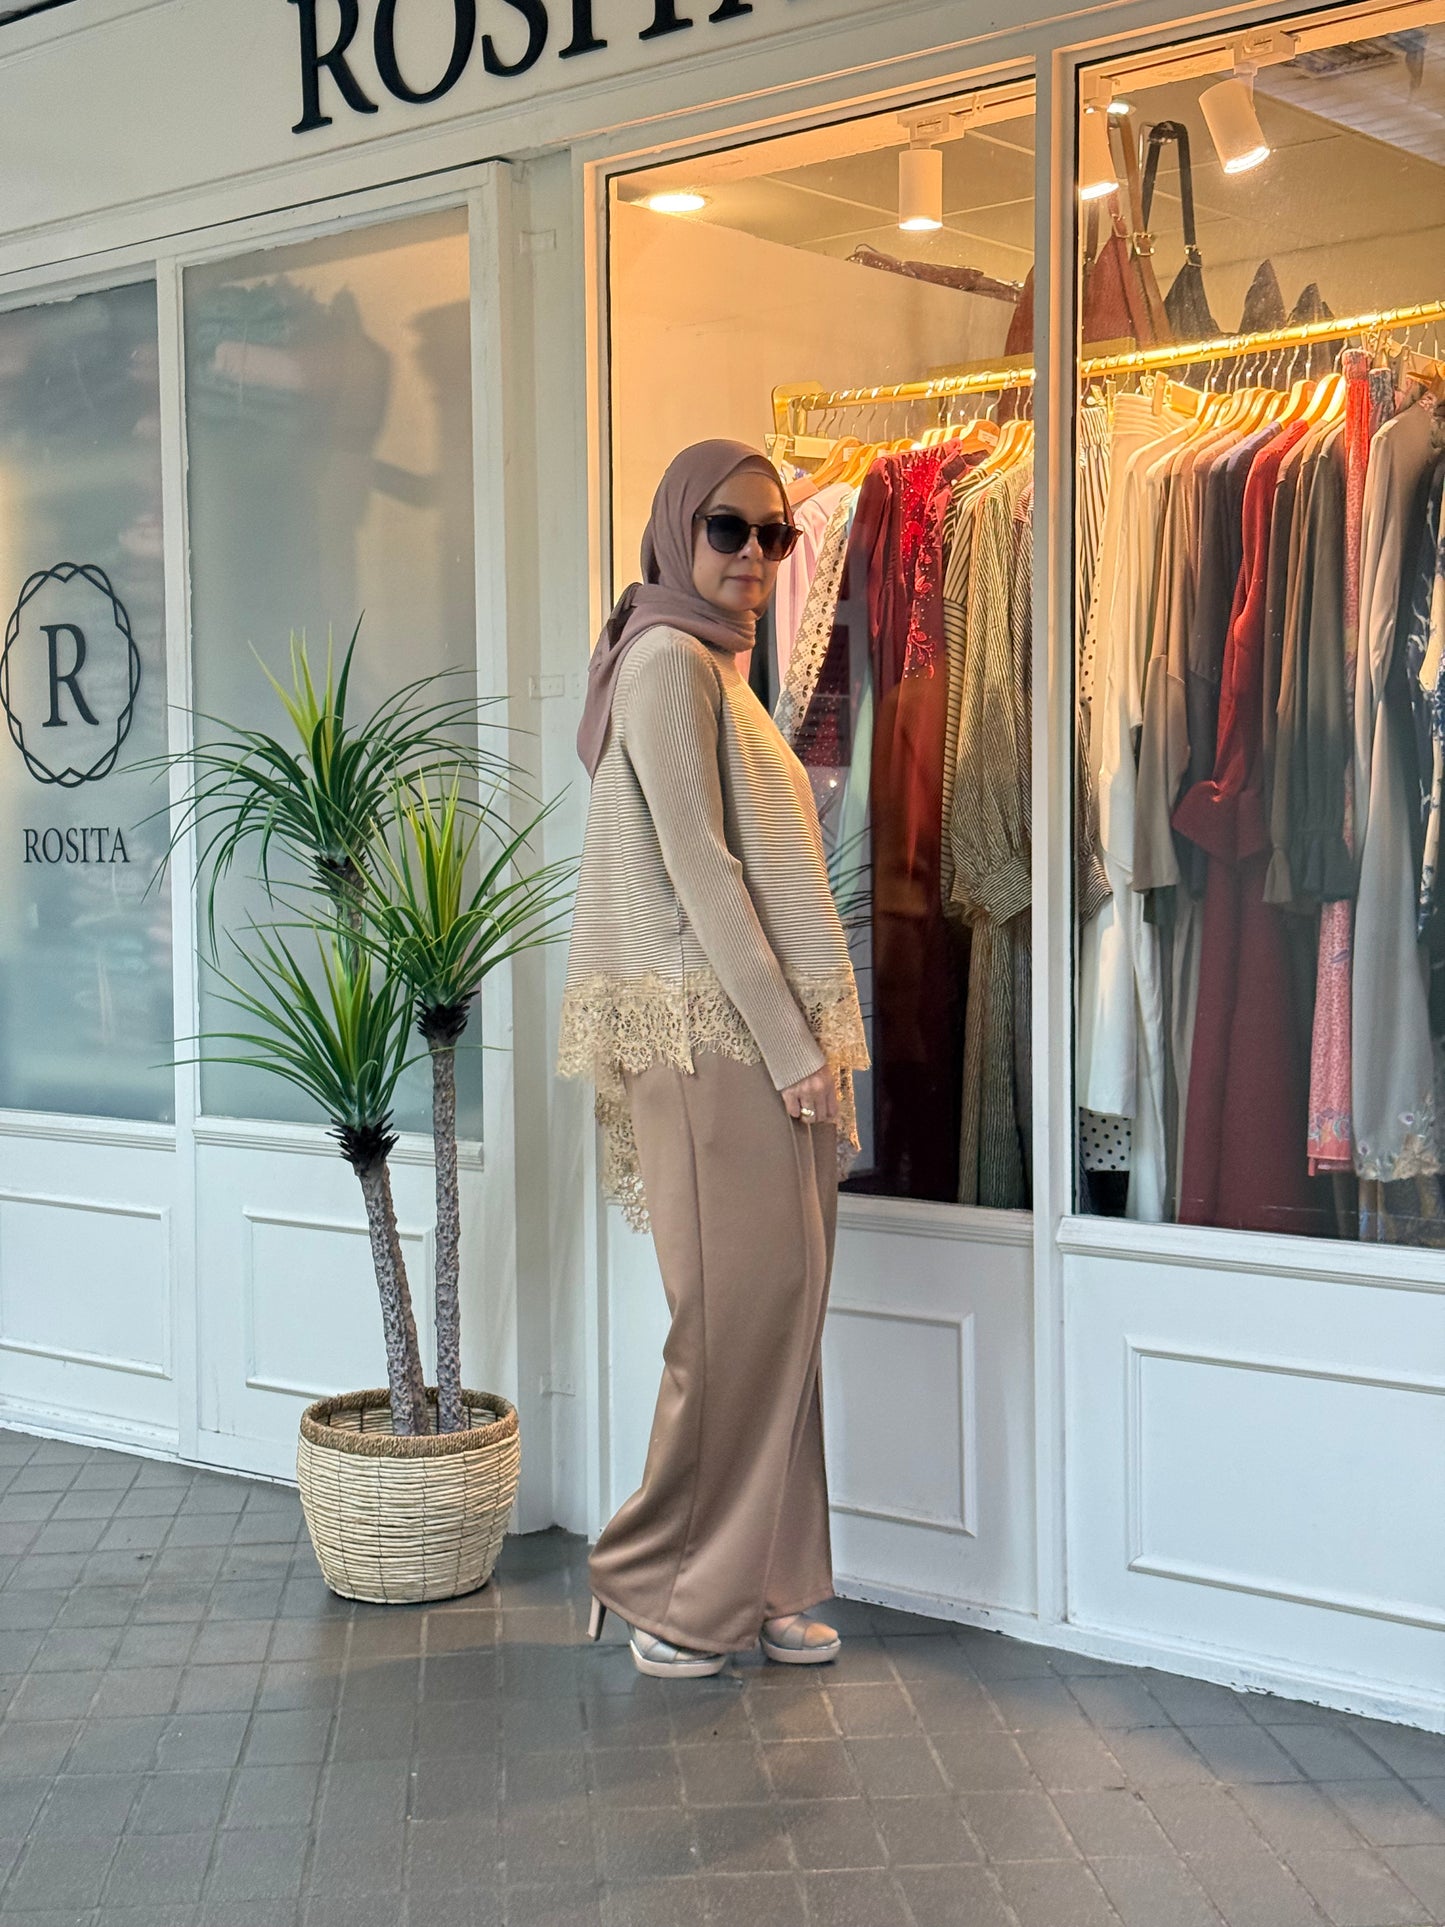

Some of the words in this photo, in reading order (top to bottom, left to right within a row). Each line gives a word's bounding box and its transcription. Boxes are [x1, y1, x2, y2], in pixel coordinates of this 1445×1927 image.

[290, 0, 755, 134] ROS
[39, 623, 100, 728] R
[22, 826, 131, 865] ROSITA
